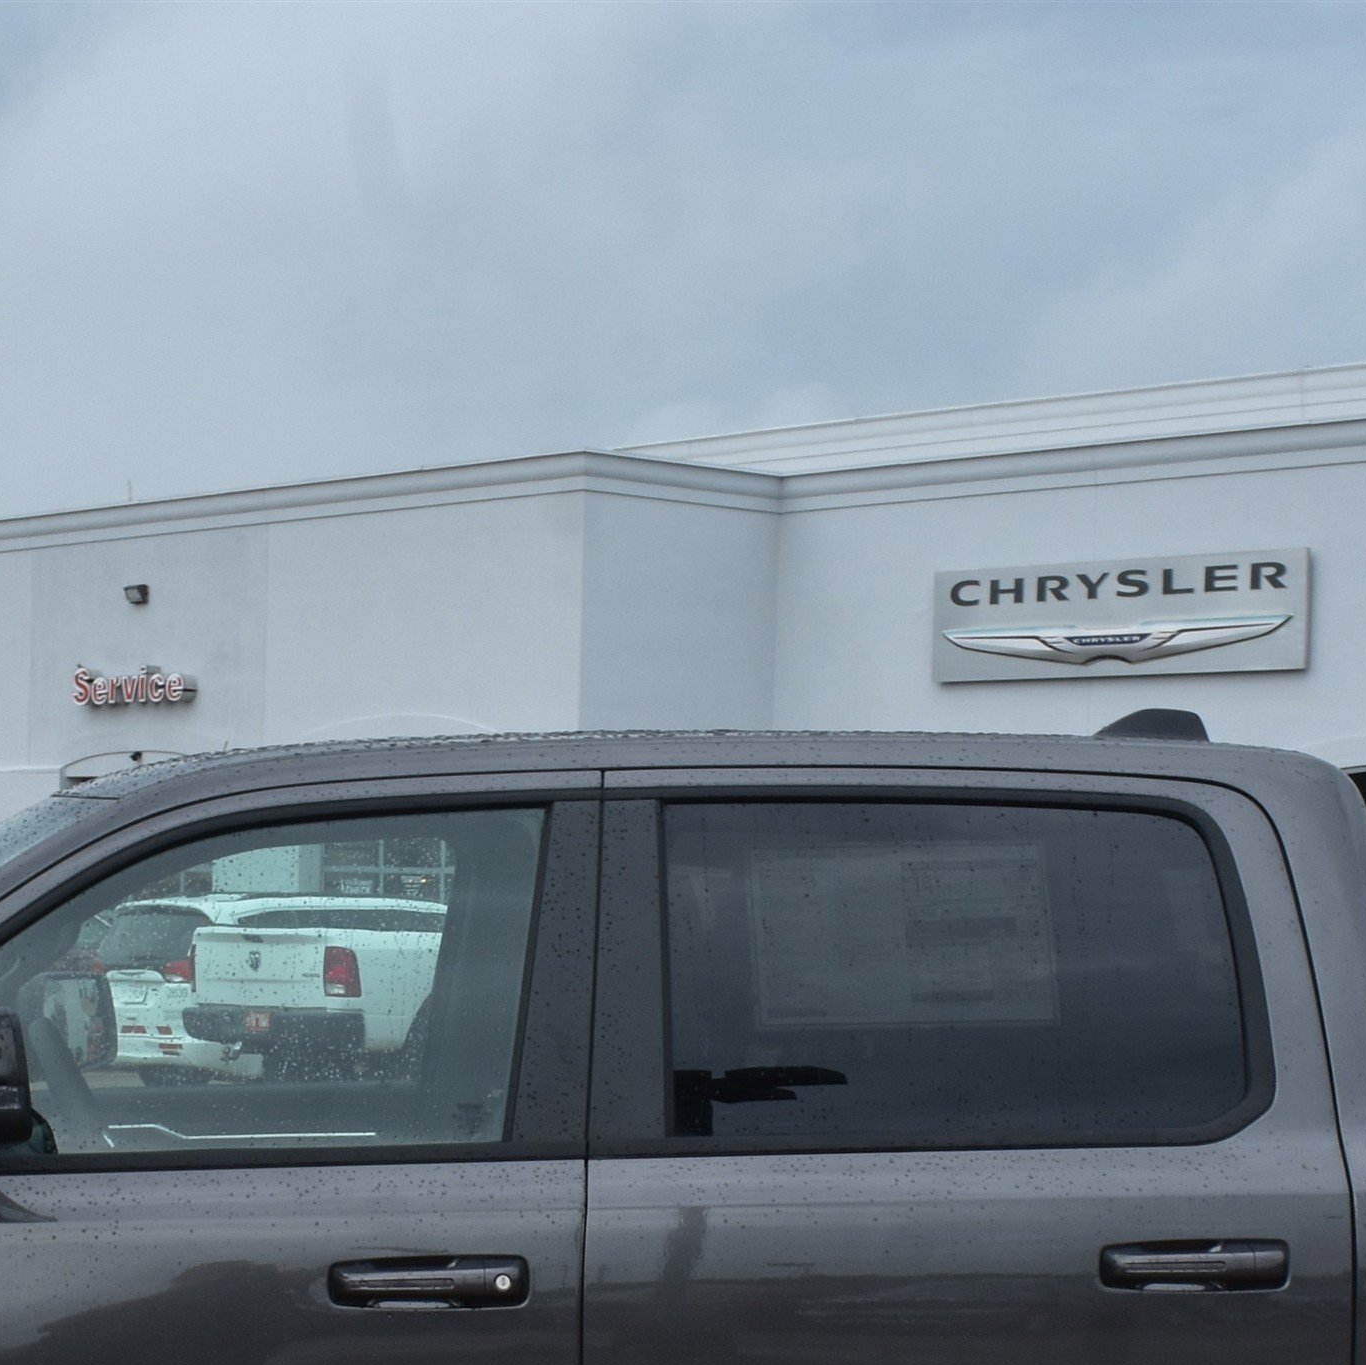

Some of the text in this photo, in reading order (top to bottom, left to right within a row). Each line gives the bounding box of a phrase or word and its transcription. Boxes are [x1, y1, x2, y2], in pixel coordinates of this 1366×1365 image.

[950, 562, 1288, 607] CHRYSLER
[1074, 634, 1142, 645] CHRYSLER
[73, 666, 184, 705] Service
